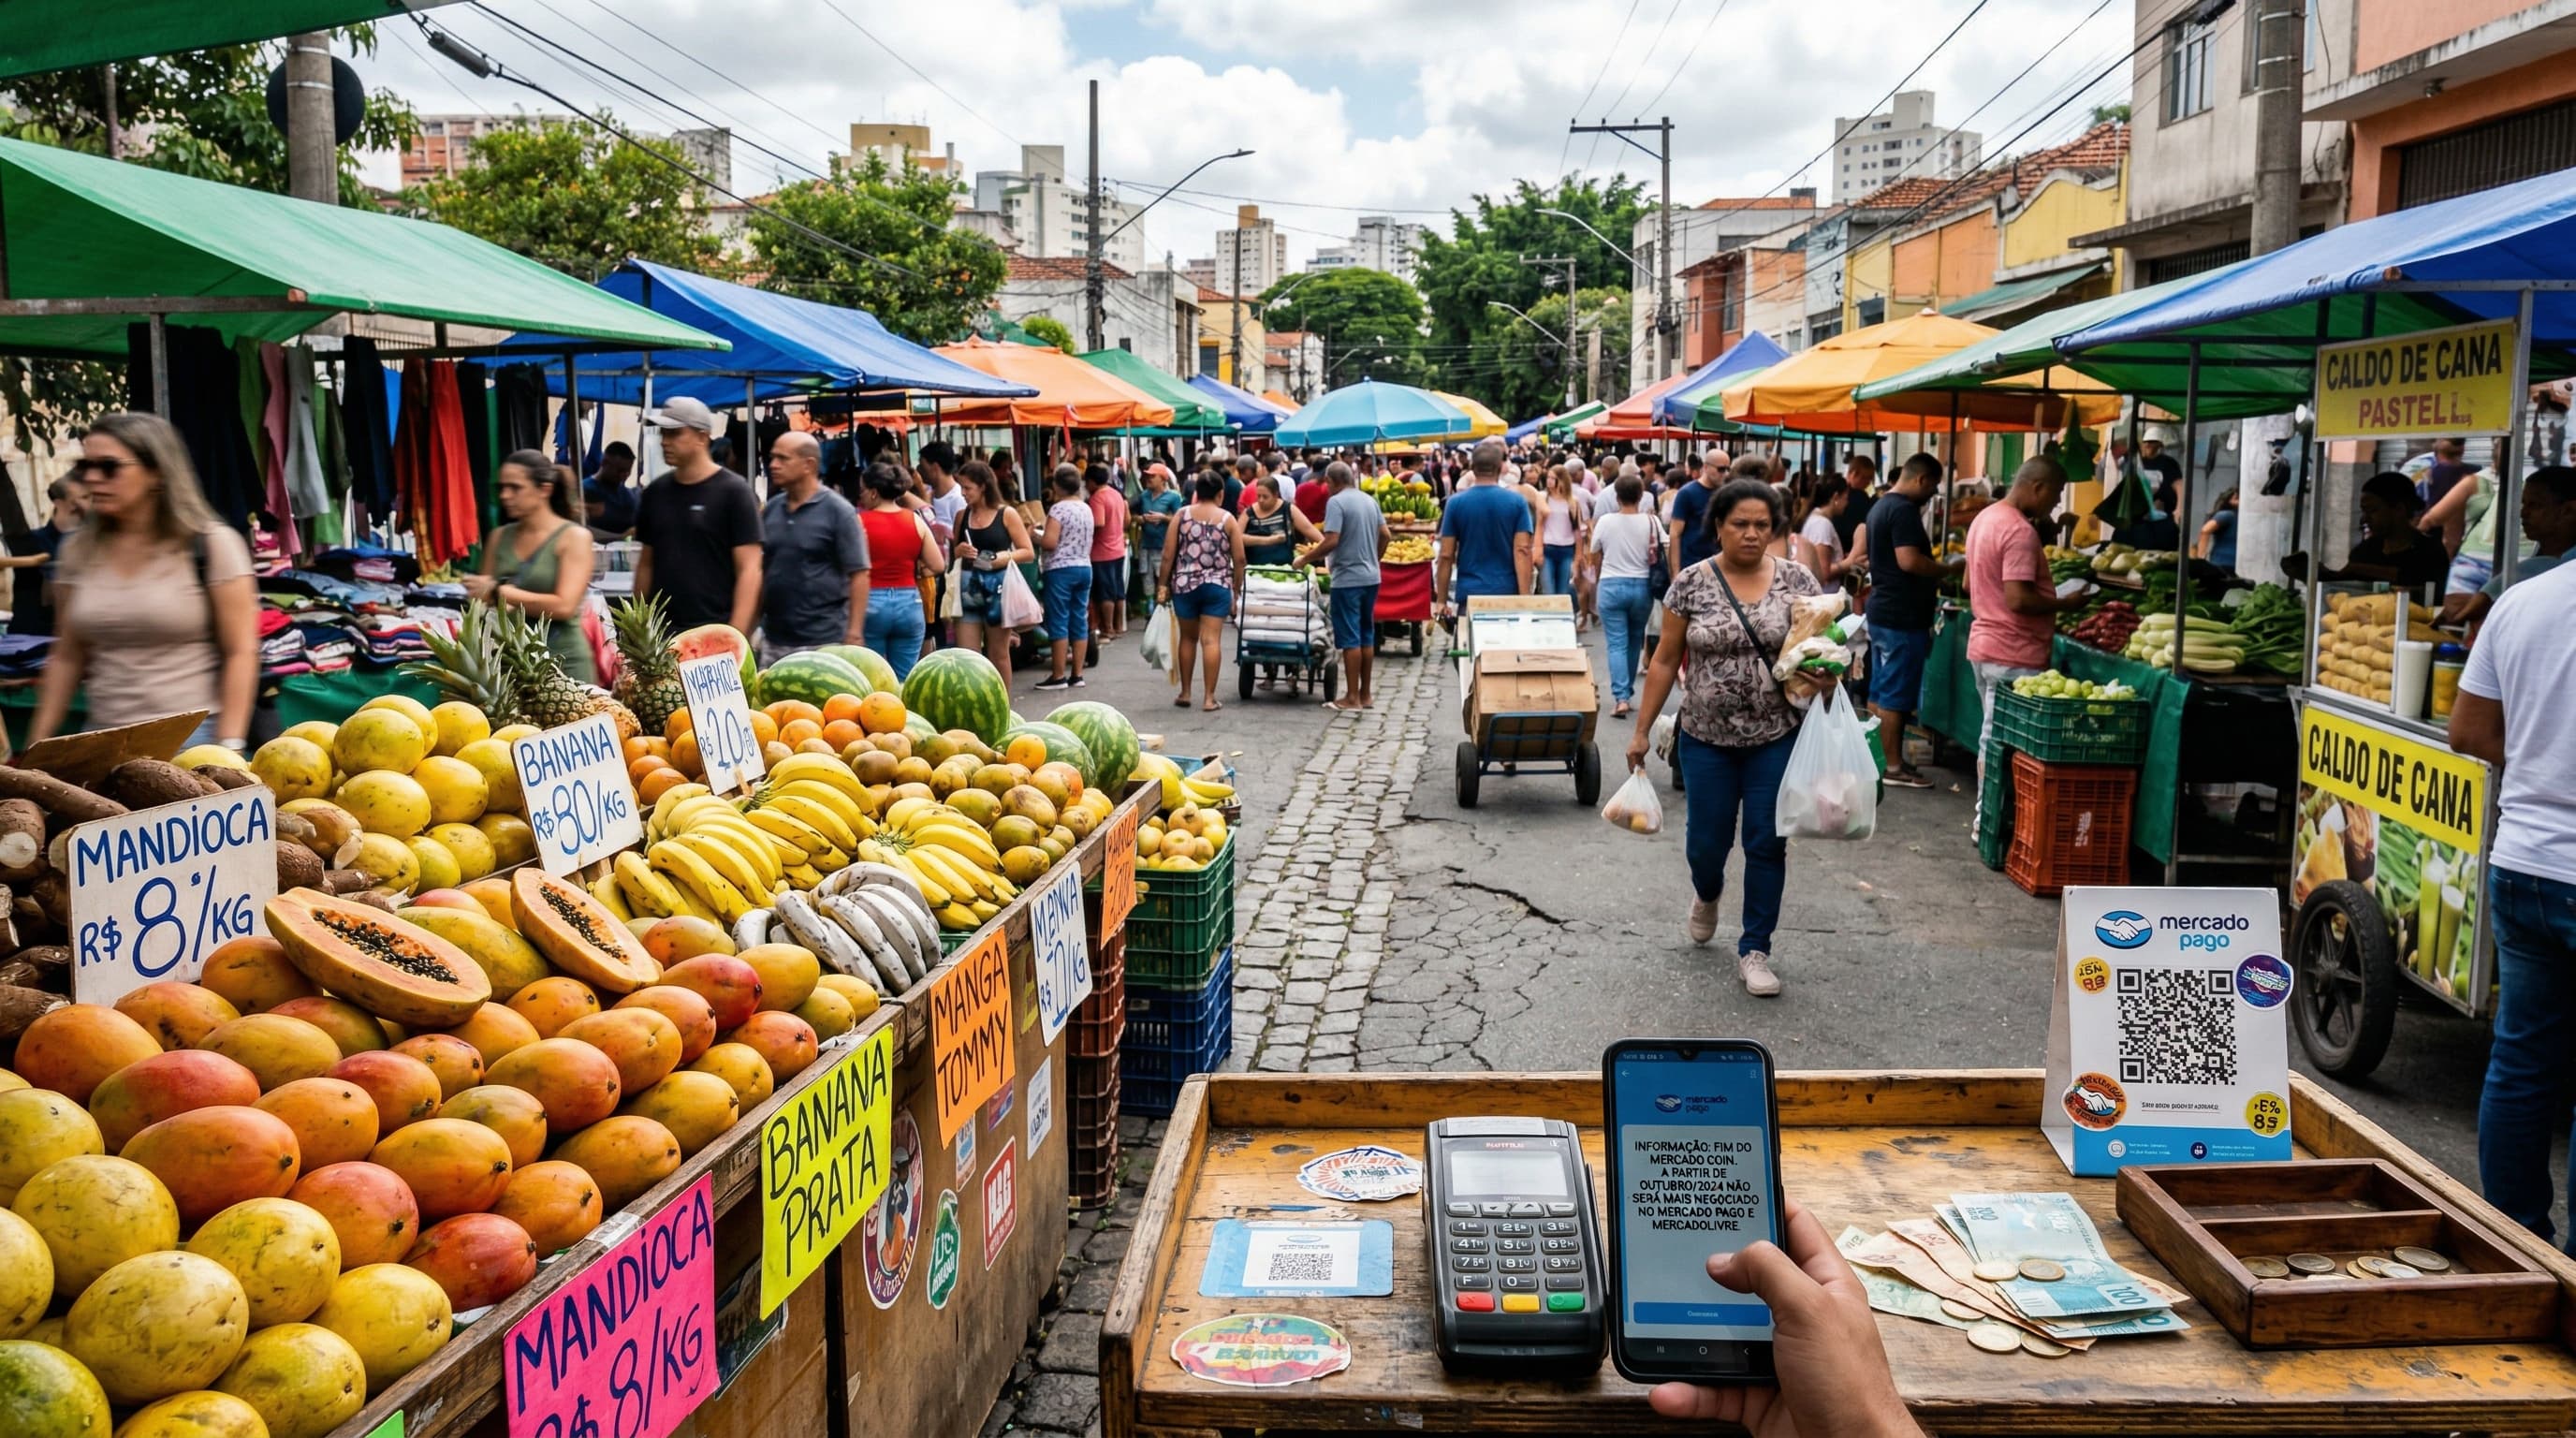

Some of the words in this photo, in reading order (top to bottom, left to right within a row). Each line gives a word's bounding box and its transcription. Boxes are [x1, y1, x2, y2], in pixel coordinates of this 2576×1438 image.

[2327, 347, 2393, 391] CALDO
[2399, 343, 2427, 385] DE
[2436, 332, 2502, 381] CANA
[520, 722, 616, 787] BANANA
[2308, 724, 2370, 790] CALDO
[2377, 746, 2405, 805] DE
[2409, 760, 2474, 835] CANA
[533, 807, 554, 842] R$
[77, 798, 269, 888] MANDIOCA
[2159, 913, 2249, 931] mercado
[80, 916, 123, 967] R$
[2179, 932, 2231, 951] pago
[934, 941, 1006, 1048] MANGA
[938, 1000, 1008, 1119] TOMMY
[1686, 1094, 1728, 1104] mercado
[768, 1038, 887, 1200] BANANA
[1634, 1139, 1711, 1153] INFORMAÇÃO:
[1714, 1142, 1734, 1152] FIM
[1736, 1142, 1752, 1152] DO
[1649, 1154, 1705, 1166] MERCADO
[1706, 1154, 1738, 1166] COIN.
[1661, 1167, 1669, 1177] A
[1672, 1167, 1711, 1178] PARTIR
[1713, 1167, 1727, 1178] DE
[1639, 1180, 1724, 1192] OUTUBRO/2024
[1726, 1180, 1750, 1191] NÃO
[781, 1124, 877, 1278] PRATA
[1632, 1190, 1661, 1204] SERÁ
[1663, 1193, 1691, 1204] MAIS
[1694, 1194, 1760, 1205] NEGOCIADO
[1638, 1207, 1655, 1217] NO
[1658, 1207, 1712, 1217] MERCADO
[1715, 1207, 1745, 1218] PAGO
[1748, 1208, 1755, 1218] E
[1458, 1222, 1466, 1230] 1
[1502, 1223, 1509, 1231] 2
[1547, 1223, 1557, 1231] 3
[1458, 1240, 1469, 1248] 4
[1504, 1240, 1514, 1249] 5
[1548, 1240, 1558, 1249] 6
[1461, 1257, 1471, 1267] 7
[1506, 1258, 1515, 1268] 8
[1550, 1257, 1560, 1267] 9
[1463, 1275, 1472, 1284] F
[2106, 1284, 2149, 1306] 100
[514, 1188, 712, 1417] MANDIOCA
